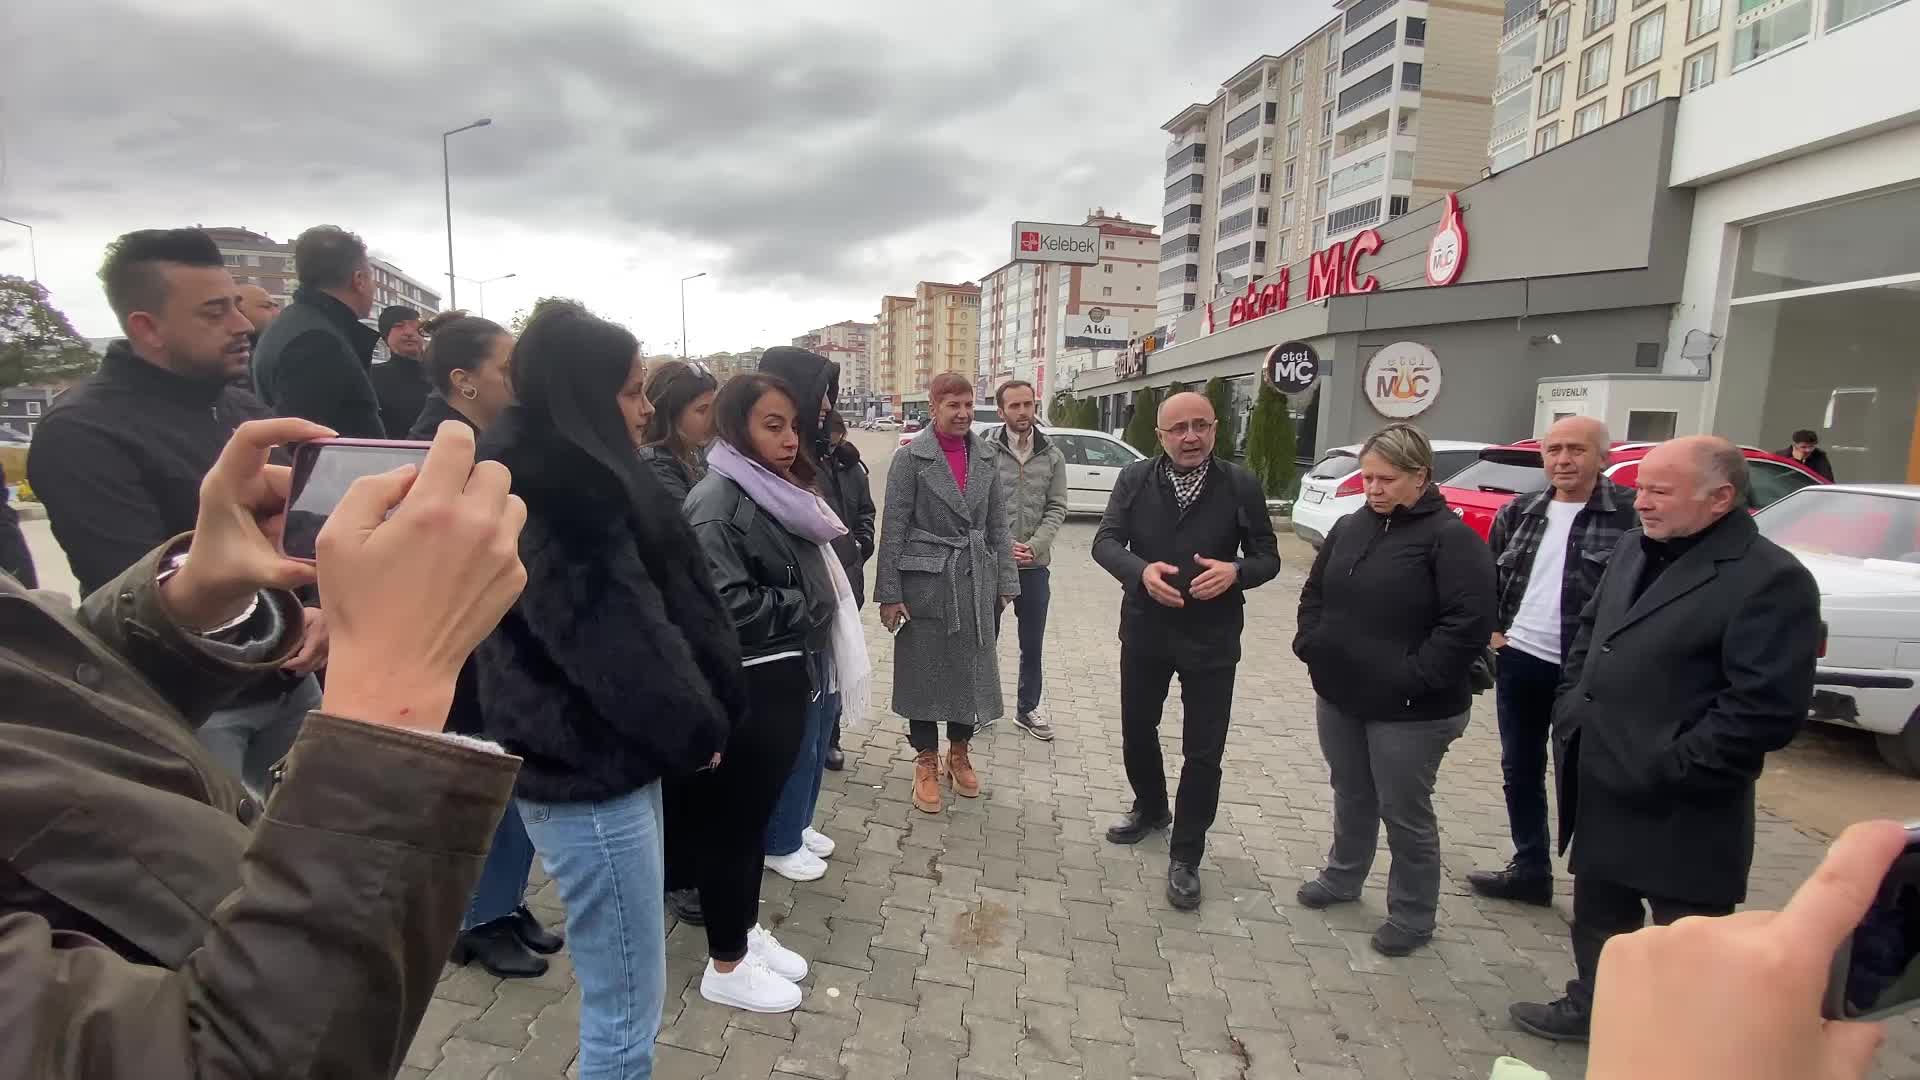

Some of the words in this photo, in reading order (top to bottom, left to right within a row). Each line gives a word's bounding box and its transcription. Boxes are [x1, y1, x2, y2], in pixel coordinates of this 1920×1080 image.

[1040, 235, 1095, 253] Kelebek
[1083, 325, 1112, 335] Akü
[1281, 350, 1309, 363] etçi
